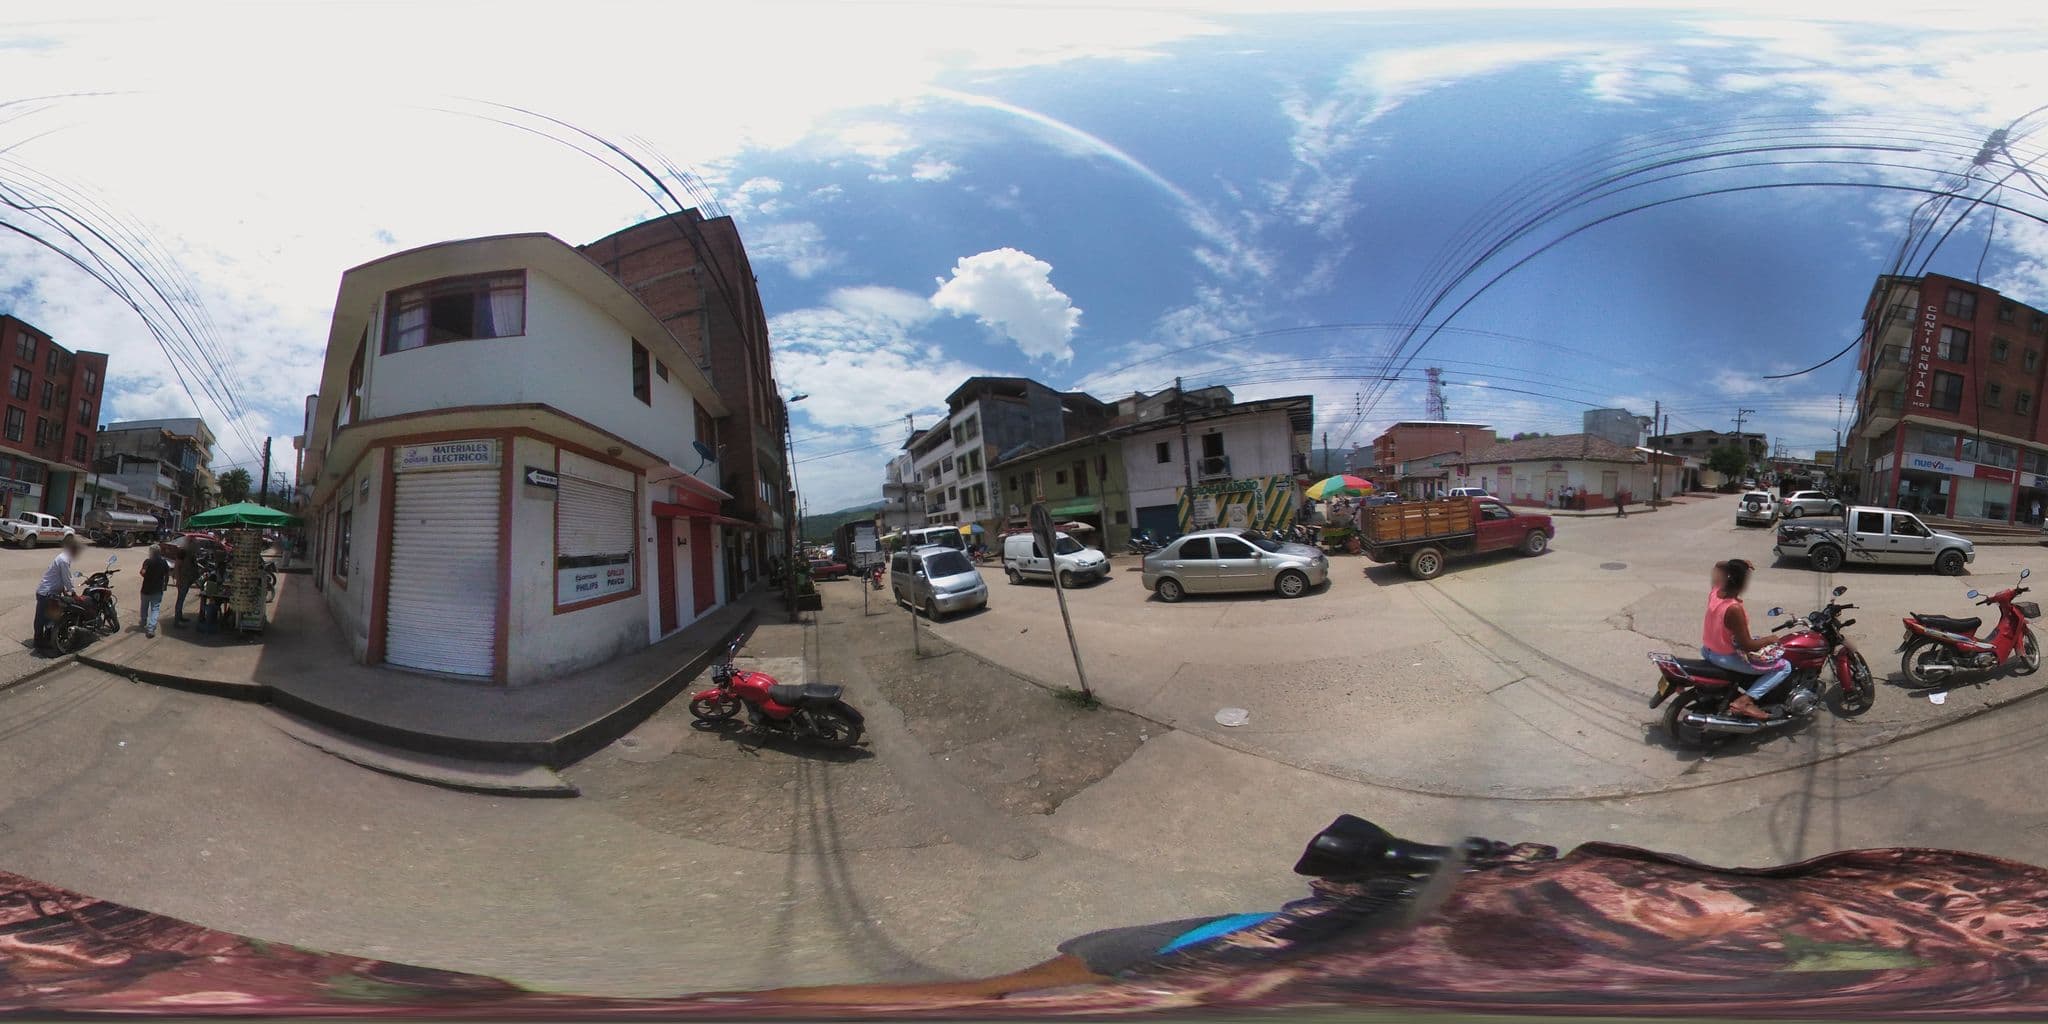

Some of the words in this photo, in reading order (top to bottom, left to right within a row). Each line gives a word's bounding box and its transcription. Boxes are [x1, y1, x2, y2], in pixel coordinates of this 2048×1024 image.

[1915, 305, 1937, 398] CONTINENTAL
[432, 443, 488, 454] MATERIALES
[432, 453, 489, 463] ELECTRICOS
[575, 581, 599, 592] PHILIPS
